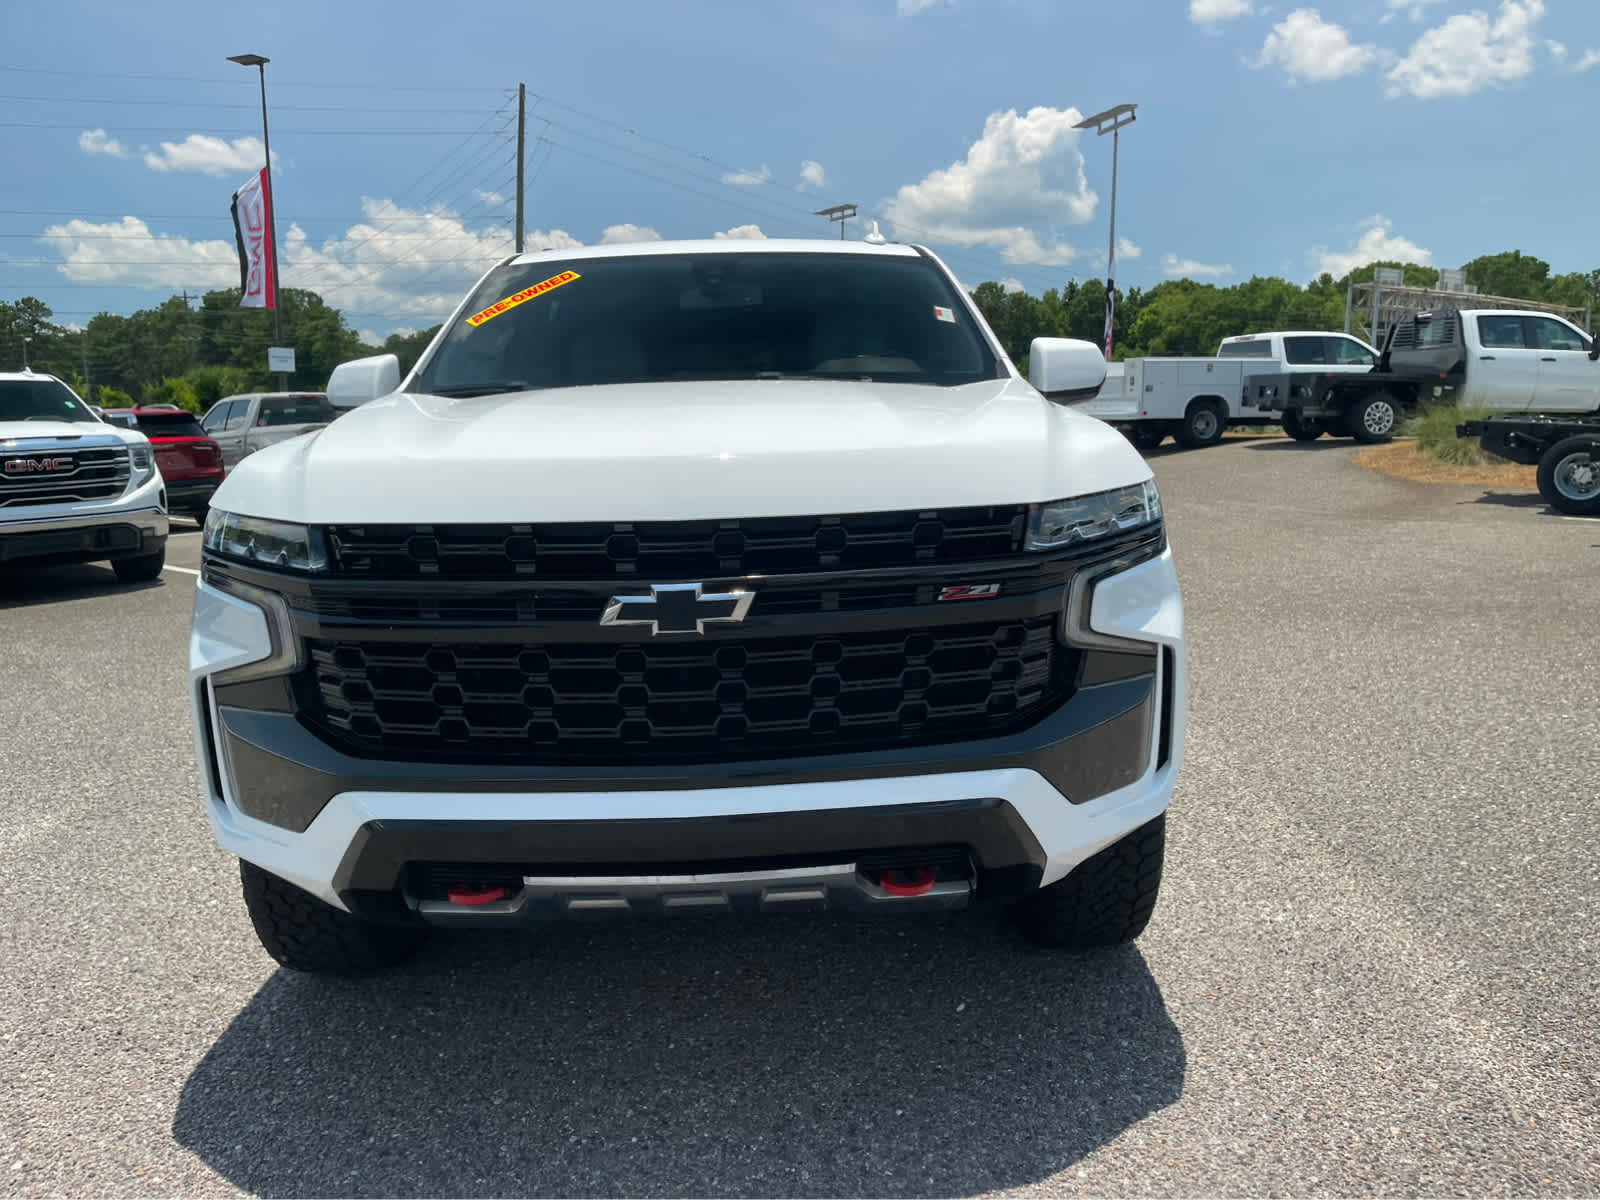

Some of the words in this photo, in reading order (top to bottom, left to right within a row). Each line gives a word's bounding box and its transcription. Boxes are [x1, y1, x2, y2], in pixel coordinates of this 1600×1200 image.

[244, 204, 262, 296] GMC
[471, 272, 573, 324] PRE-OWNED
[5, 457, 74, 472] GMC
[938, 583, 1000, 600] Z71
